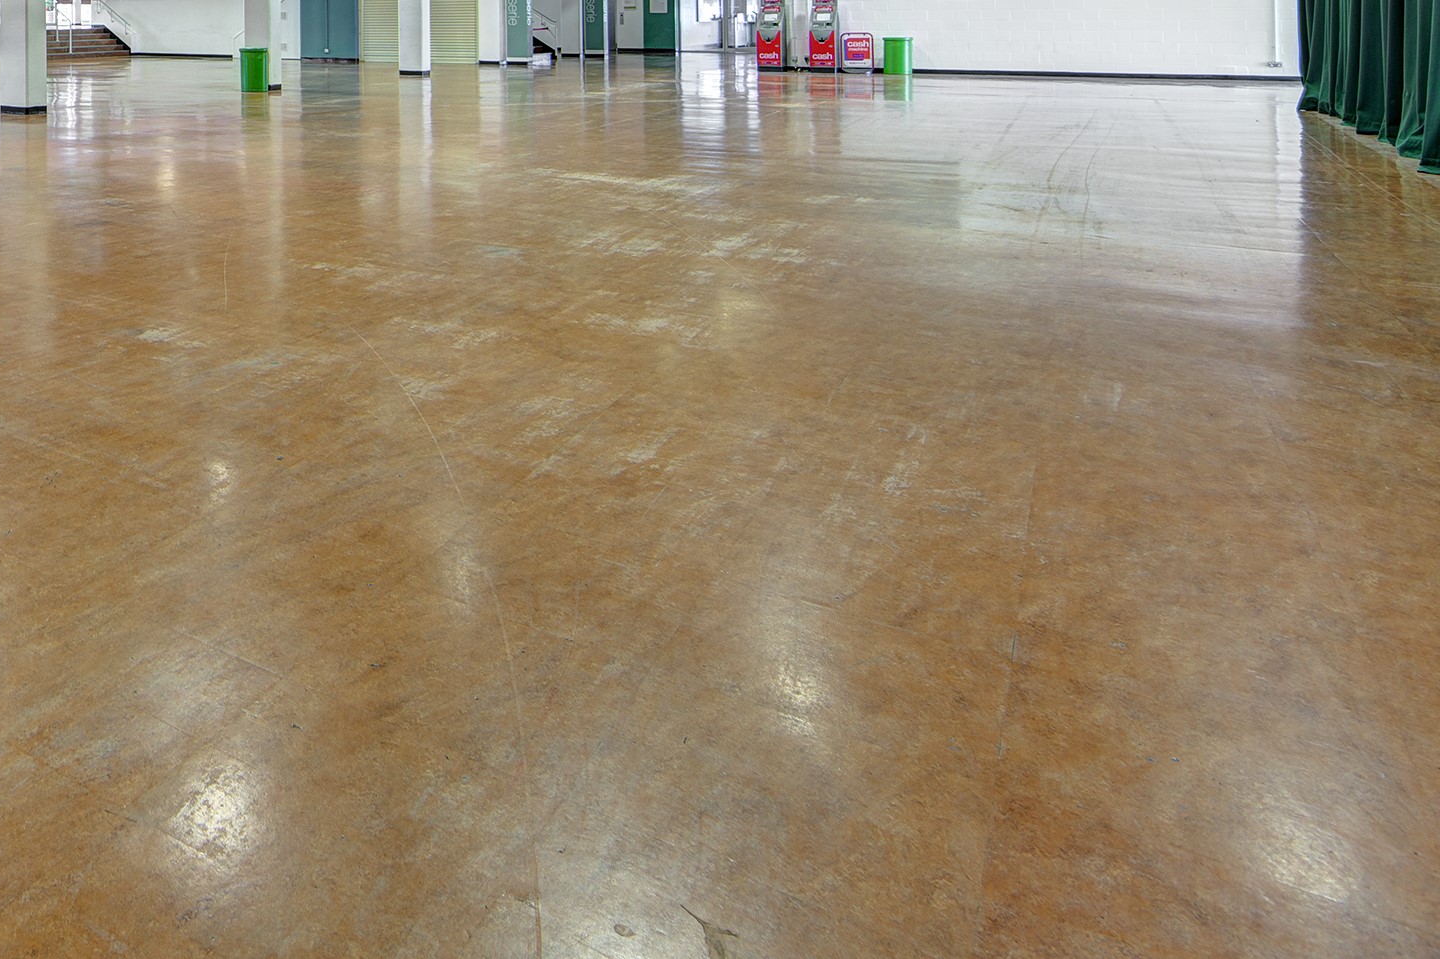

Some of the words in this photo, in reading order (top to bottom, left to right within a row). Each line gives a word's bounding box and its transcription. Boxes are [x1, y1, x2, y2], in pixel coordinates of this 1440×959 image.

[847, 40, 869, 48] cash
[759, 51, 779, 59] cash
[812, 52, 833, 60] cash
